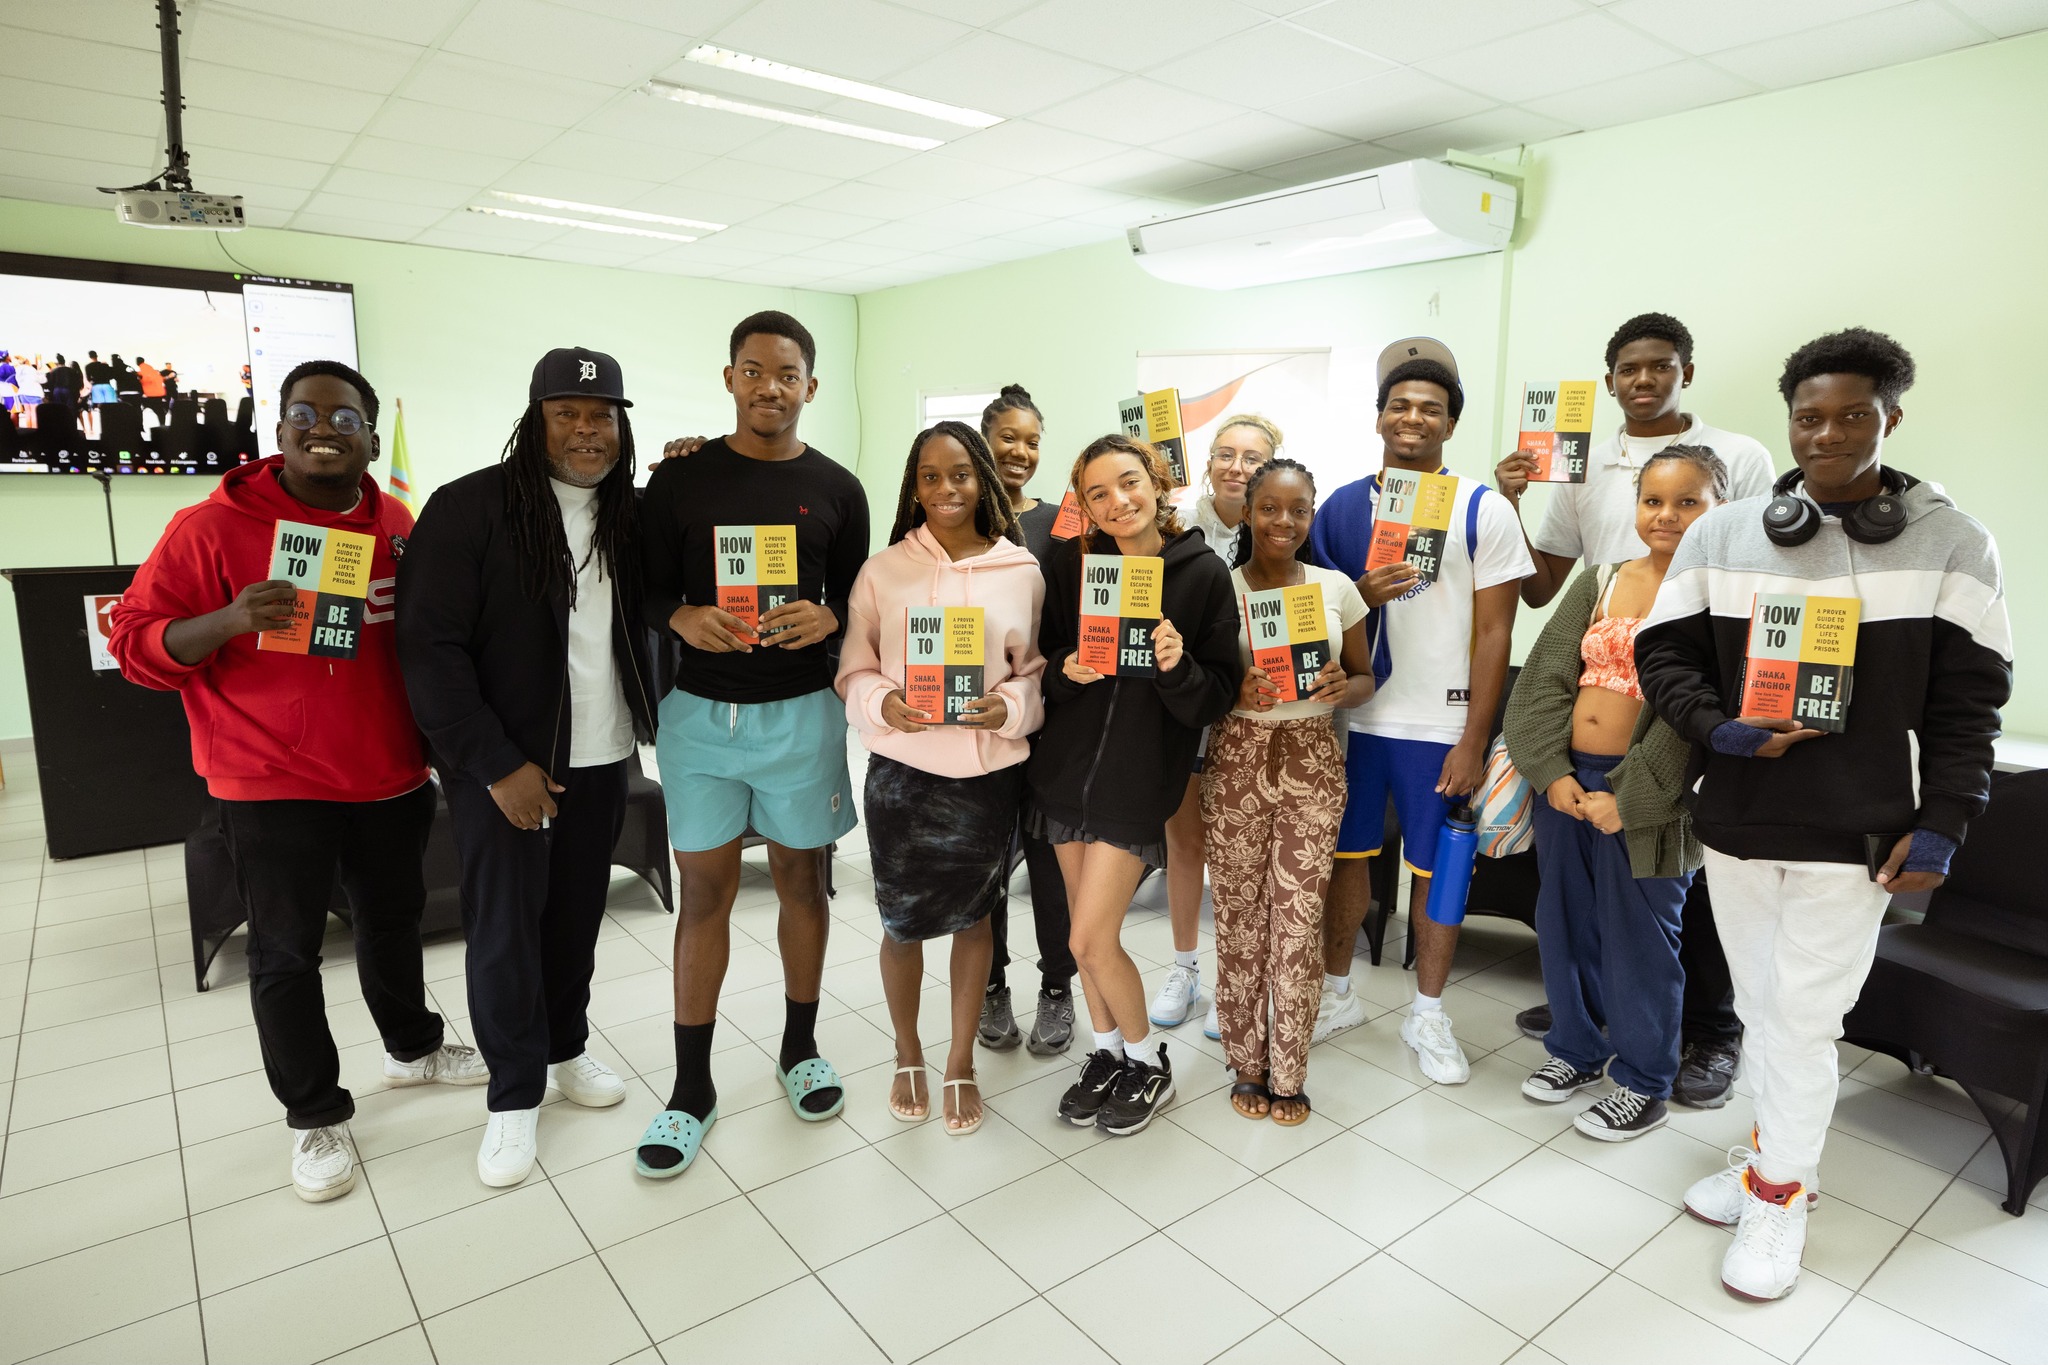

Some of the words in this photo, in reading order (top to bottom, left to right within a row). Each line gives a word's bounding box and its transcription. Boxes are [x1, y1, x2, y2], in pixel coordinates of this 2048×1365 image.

[579, 359, 597, 382] D
[1527, 391, 1555, 404] HOW
[1122, 405, 1143, 423] HOW
[1533, 409, 1546, 422] TO
[1128, 424, 1140, 437] TO
[1160, 448, 1173, 462] BE
[1562, 441, 1578, 455] BE
[1553, 459, 1583, 473] FREE
[1385, 478, 1416, 496] HOW
[1389, 498, 1404, 514] TO
[281, 533, 322, 556] HOW
[342, 543, 363, 551] PROVEN
[720, 537, 752, 554] HOW
[1416, 536, 1433, 553] BE
[288, 557, 307, 577] TO
[334, 556, 361, 565] ESCAPING
[728, 558, 745, 575] TO
[1406, 554, 1436, 573] FREE
[1087, 566, 1119, 584] HOW
[769, 595, 785, 610] BE
[1093, 588, 1109, 605] TO
[327, 605, 349, 625] BE
[1250, 600, 1281, 619] HOW
[1294, 607, 1315, 615] ESCAPING
[1758, 605, 1801, 625] HOW
[911, 618, 941, 633] HOW
[1261, 621, 1277, 638] TO
[314, 626, 355, 649] FREE
[1083, 635, 1114, 643] SENGHOR
[1129, 628, 1146, 645] BE
[1766, 629, 1786, 648] TO
[917, 638, 933, 654] TO
[1120, 649, 1152, 667] FREE
[1262, 657, 1284, 665] SHAKA
[1302, 651, 1320, 669] BE
[1261, 665, 1290, 673] ENGHOR
[1757, 670, 1785, 680] SHAKA
[955, 676, 971, 692] BE
[1750, 680, 1790, 691] SENGHOR
[1810, 675, 1834, 695] BE
[1797, 698, 1841, 720] FREE
